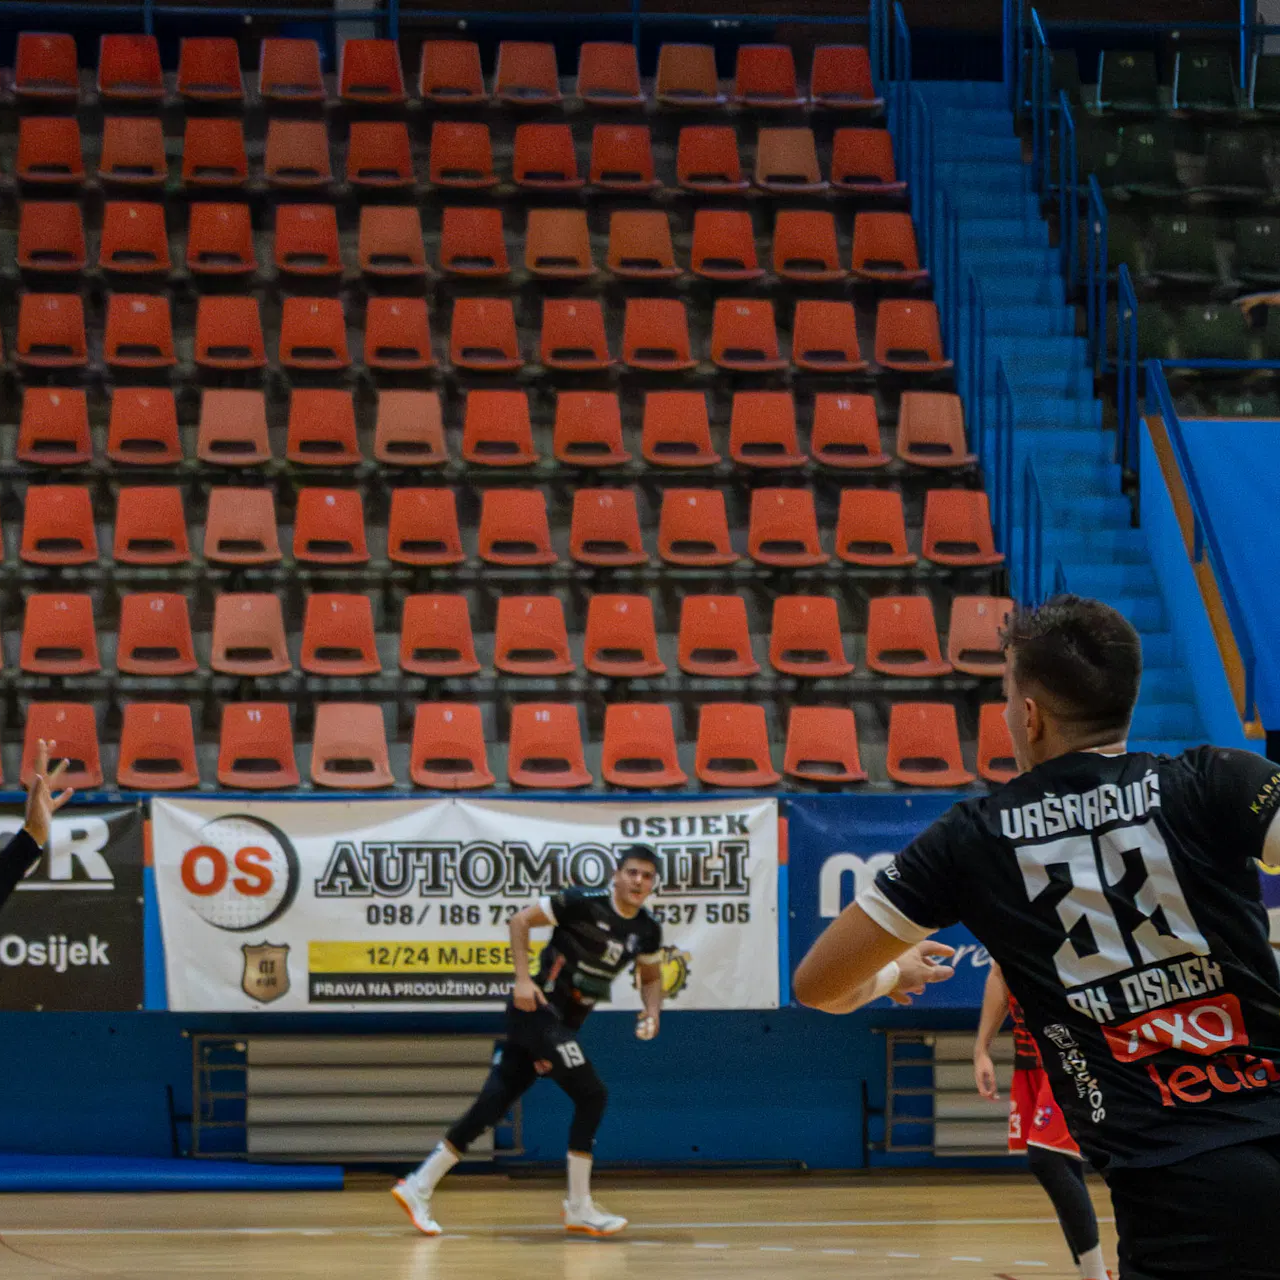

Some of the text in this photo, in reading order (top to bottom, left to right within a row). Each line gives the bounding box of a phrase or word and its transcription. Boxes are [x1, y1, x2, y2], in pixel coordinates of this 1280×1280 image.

[620, 814, 751, 838] OSIJEK
[180, 845, 276, 897] OS
[314, 840, 750, 898] AUTOMOILI
[439, 904, 481, 926] 186
[706, 904, 751, 926] 505
[365, 947, 431, 966] 12/24
[314, 981, 365, 998] PRAVA
[368, 981, 391, 998] NA
[1120, 956, 1225, 1014] OSIJEK
